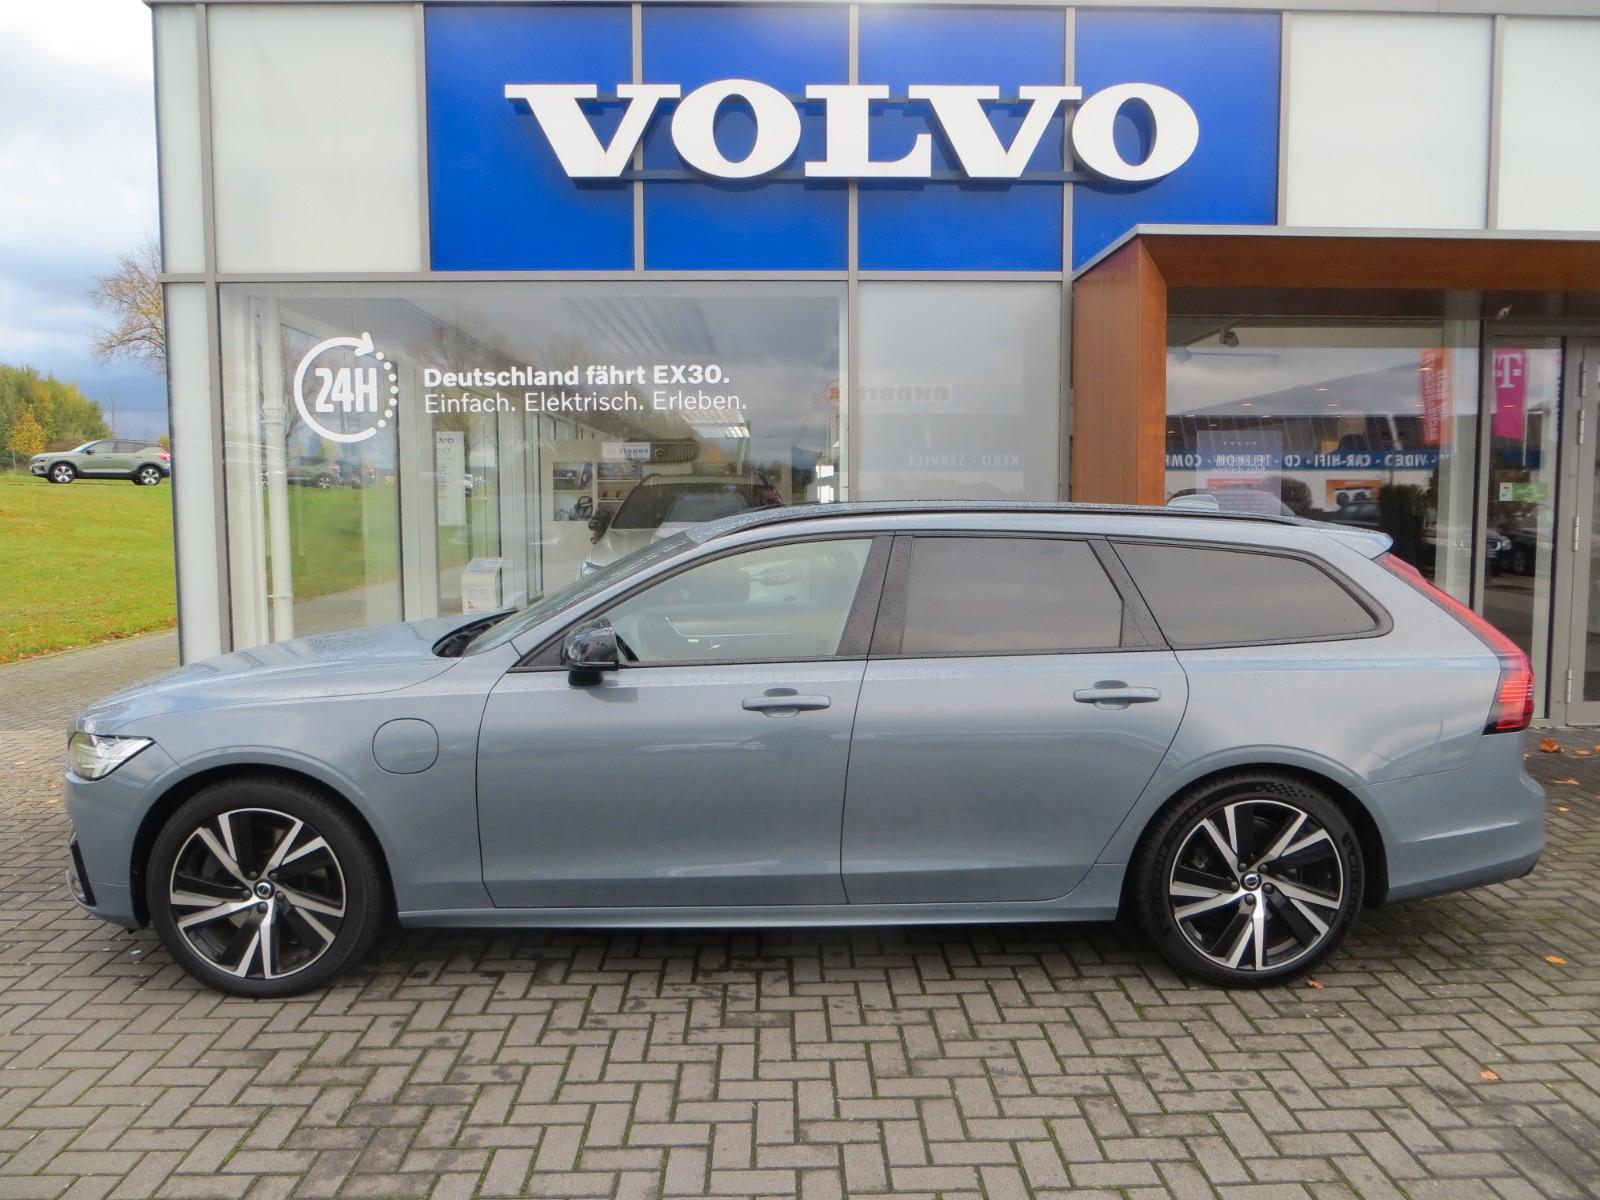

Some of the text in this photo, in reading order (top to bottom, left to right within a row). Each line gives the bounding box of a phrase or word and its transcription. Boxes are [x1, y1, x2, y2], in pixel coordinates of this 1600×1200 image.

[504, 78, 1199, 182] VOLVO
[315, 367, 378, 413] 24H
[423, 364, 730, 388] Deutschland fährt EX30.
[425, 390, 747, 414] Einfach. Elektrisch. Erleben.
